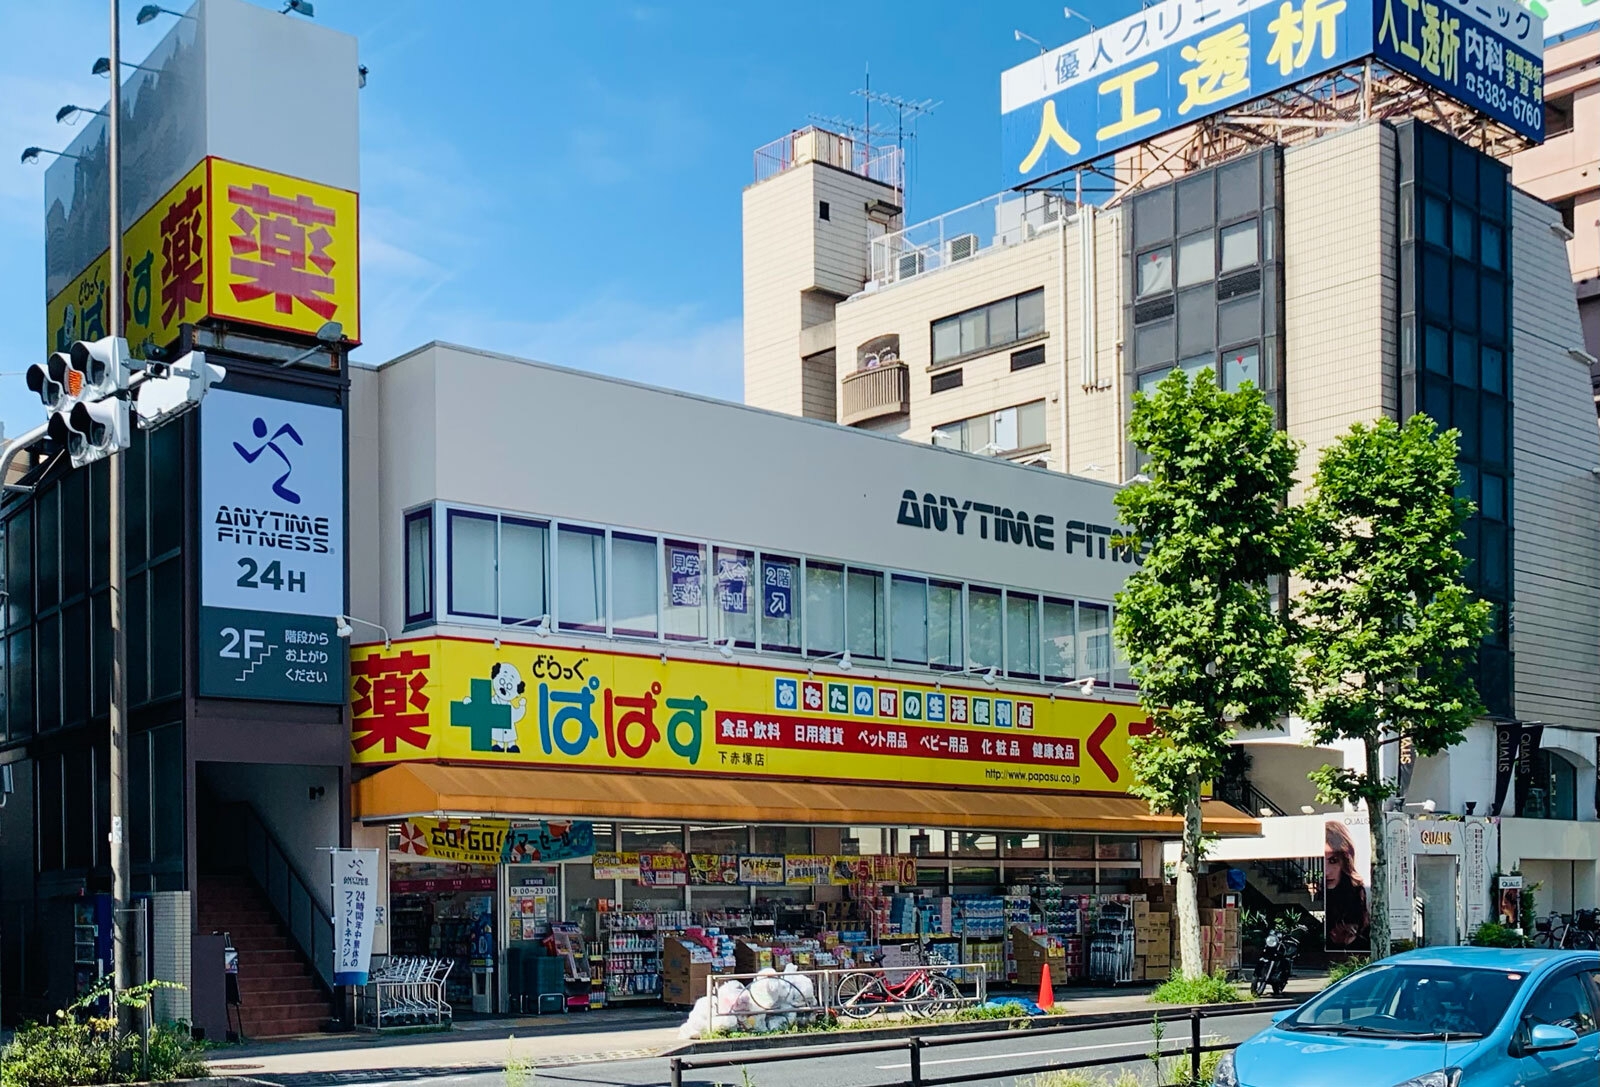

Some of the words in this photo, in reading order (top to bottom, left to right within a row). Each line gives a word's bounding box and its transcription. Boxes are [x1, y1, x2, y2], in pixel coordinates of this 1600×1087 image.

[1465, 27, 1505, 82] 内科
[1018, 0, 1347, 174] 人工透析
[160, 185, 203, 330] 薬
[228, 184, 337, 320] 薬
[216, 505, 329, 537] ANYTIME
[897, 489, 1055, 551] ANYTIME
[217, 527, 328, 554] FITNESS
[237, 557, 306, 593] 24H
[765, 566, 790, 589] 2階
[219, 627, 265, 660] 2F
[285, 629, 329, 646] 階段から
[285, 649, 329, 664] お上がり
[532, 654, 589, 681] どらっぐ
[285, 668, 328, 683] ください
[352, 650, 431, 755] 薬
[539, 676, 708, 765] ぱぱす
[778, 682, 1034, 727] あなたの町の生活便利店
[718, 751, 765, 767] 下赤塚店
[794, 724, 845, 746] 日用雑貨
[858, 729, 908, 749] ペット用品
[920, 734, 969, 754] ベビー用品
[981, 738, 1020, 757] 化粧品
[1032, 740, 1075, 761] 健康食品
[1498, 730, 1510, 773] QUALIS
[985, 768, 1081, 785] http://www.papasu.co.jp
